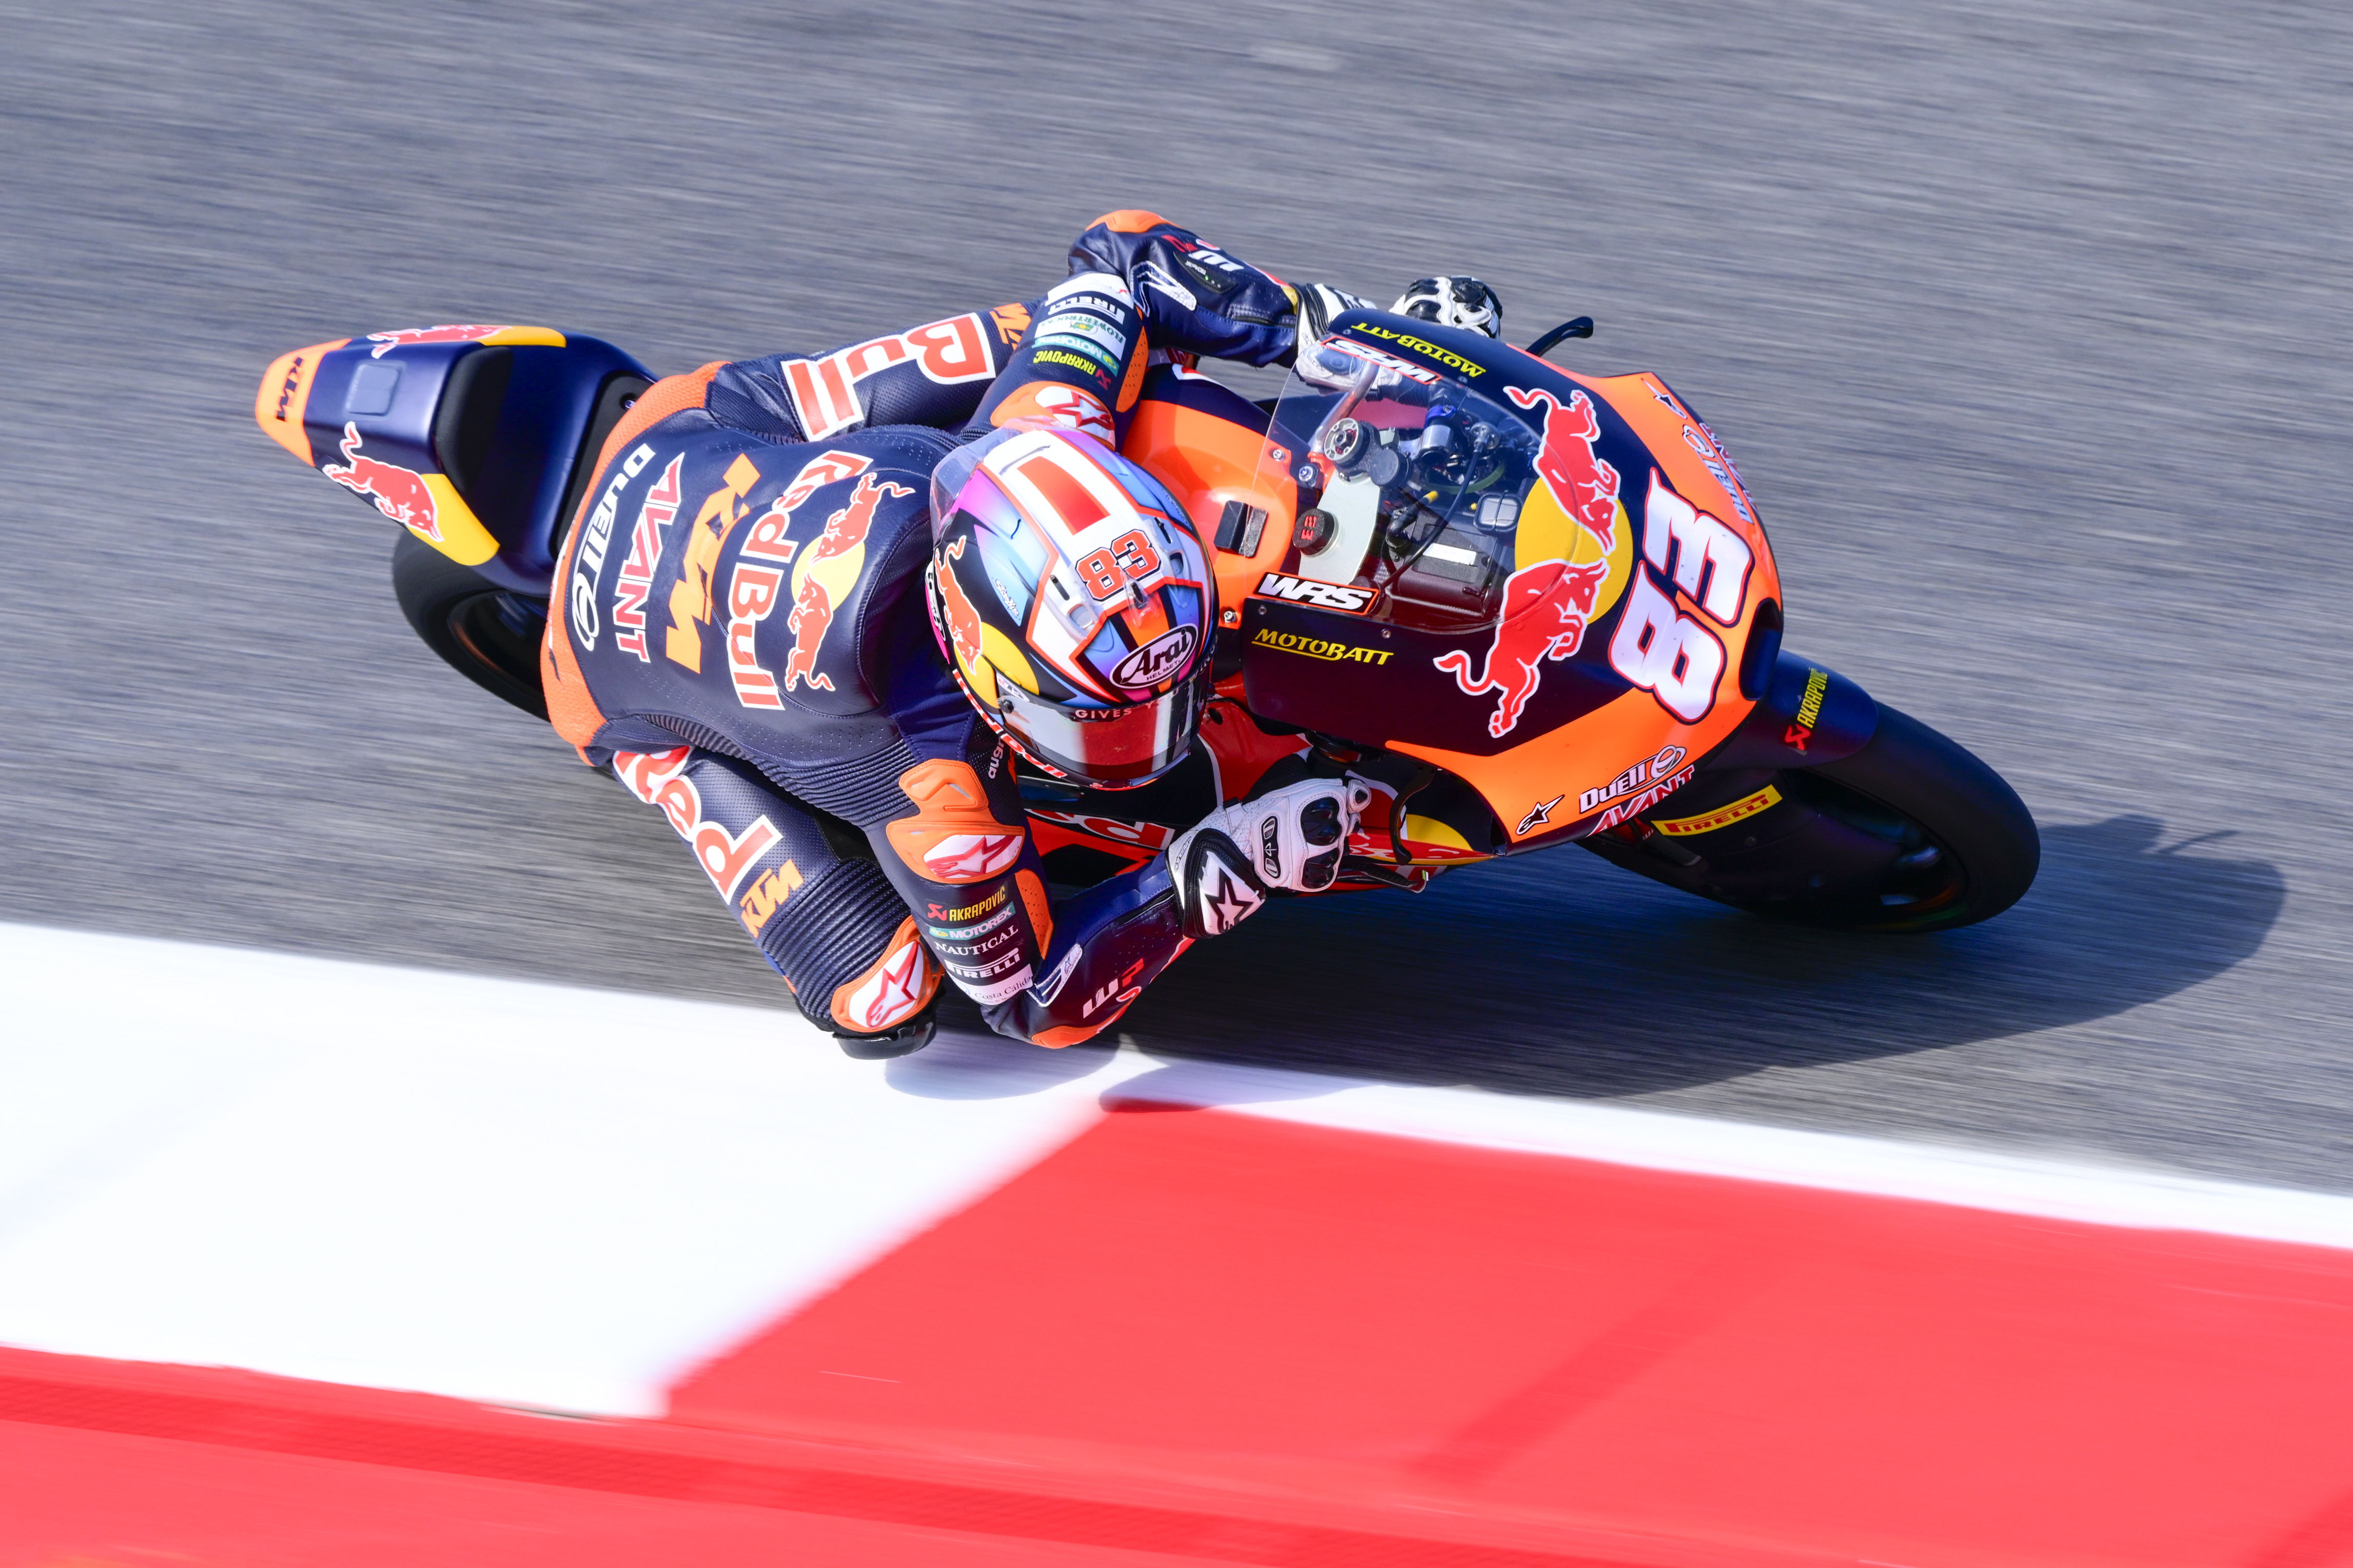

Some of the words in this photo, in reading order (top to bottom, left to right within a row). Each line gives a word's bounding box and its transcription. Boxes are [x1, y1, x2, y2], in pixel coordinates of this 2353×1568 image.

[780, 312, 996, 442] Bull
[1326, 340, 1436, 382] WRS
[1351, 323, 1486, 378] MOTOBATT
[277, 356, 303, 422] KTM
[739, 450, 873, 563] Red
[613, 452, 685, 663] AVANT
[666, 452, 761, 674] KTM
[1075, 529, 1161, 602] 83
[1258, 573, 1372, 610] WRS
[1607, 467, 1755, 725] 83
[727, 562, 785, 710] Bull
[1120, 627, 1190, 684] Arai
[1251, 628, 1394, 665] MOTOBATT
[1147, 660, 1180, 681] HELMET
[1075, 707, 1132, 719] GIVES
[612, 745, 783, 905] Red
[1586, 764, 1694, 838] AVANT
[1664, 795, 1769, 833] PIRELLI
[739, 859, 805, 938] KTM
[949, 885, 1006, 922] AKRAPOVIČ
[949, 906, 1012, 939] MOTOREX
[934, 925, 1018, 956] NAUTICAL
[944, 947, 1021, 978] PIRELLI
[975, 991, 1002, 1000] Costa
